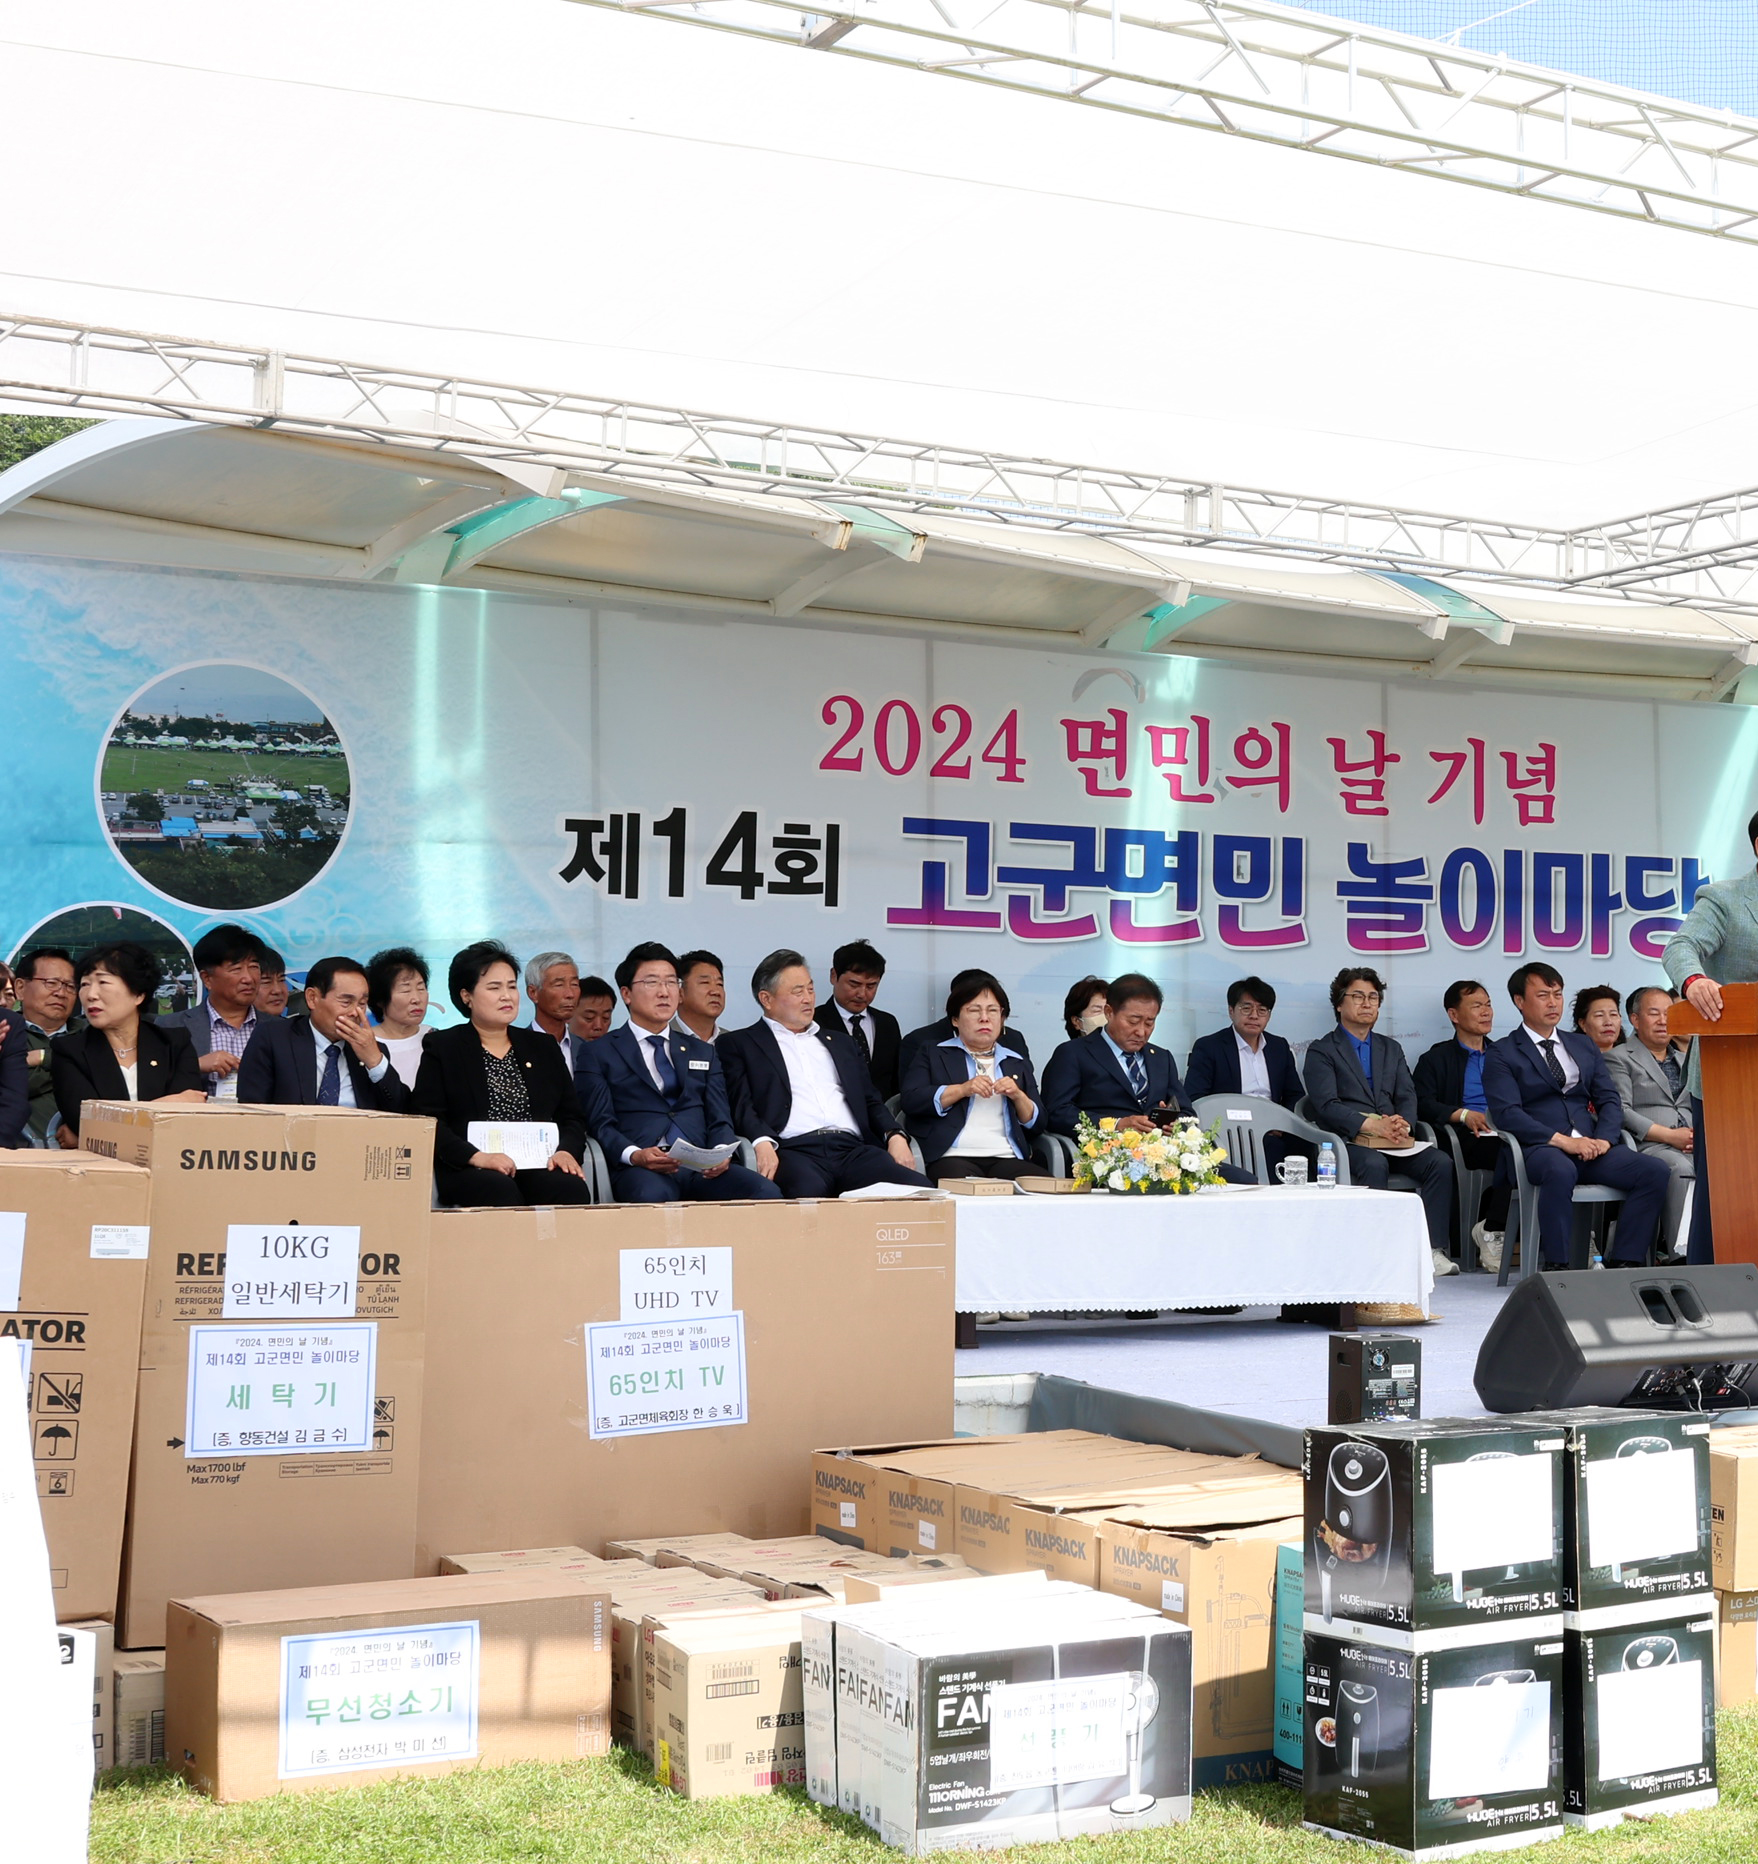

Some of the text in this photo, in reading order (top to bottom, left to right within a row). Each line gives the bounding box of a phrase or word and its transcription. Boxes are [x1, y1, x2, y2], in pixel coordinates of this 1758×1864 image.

[819, 695, 1557, 827] 2024 면민의 날 기념
[559, 807, 1712, 961] 제14회 고군면민 놀이마당
[180, 1149, 317, 1172] SAMSUNG
[876, 1229, 909, 1242] QLED
[260, 1236, 330, 1258] 10KG
[644, 1254, 707, 1276] 65인치
[232, 1282, 349, 1305] 일반세탁기
[634, 1290, 719, 1309] UHD TV
[268, 1338, 293, 1346] 면민의
[651, 1329, 674, 1338] 면민의
[677, 1328, 685, 1337] 날
[600, 1336, 731, 1358] 제14회 고군면민 놀이마당
[206, 1350, 360, 1366] 제14회 고군면민 놀이마당
[609, 1366, 725, 1396] 65인치 TV
[187, 1462, 246, 1473] Max 1700 lbf
[192, 1475, 240, 1484] Max 770 kgf
[816, 1470, 865, 1500] KNAPSACK
[889, 1491, 944, 1517] KNAPSACK
[961, 1505, 1010, 1535] KNAPSAC
[1025, 1528, 1086, 1560] KNAPSACK
[1113, 1545, 1179, 1577] KNAPSACK
[1642, 1582, 1681, 1594] AIR FRYER
[1683, 1571, 1708, 1589] 5.5L
[1487, 1603, 1529, 1615] AIR FRYER
[1532, 1592, 1559, 1610] 5.5L
[1731, 1599, 1742, 1608] LG
[1368, 1609, 1387, 1618] FRYER
[1388, 1605, 1409, 1623] 5.5L
[593, 1601, 602, 1652] SAMSUNG
[364, 1643, 391, 1653] 면민의
[397, 1641, 405, 1651] 날
[299, 1652, 461, 1679] 제14회 고군면민 놀이마당
[803, 1658, 830, 1691] FAN
[1355, 1662, 1388, 1673] AIR FRYER
[1390, 1661, 1410, 1679] 5.5L
[939, 1673, 960, 1683] 바람의
[962, 1682, 983, 1693] 기계식
[306, 1686, 453, 1725] 무선청소기
[884, 1692, 914, 1730] FAN
[339, 1743, 388, 1761] 삼성전자
[1688, 1767, 1712, 1787] 5.5L
[929, 1782, 950, 1791] Electric
[1342, 1786, 1369, 1798] KAF-2055
[1648, 1781, 1686, 1794] AIR FRYER
[1531, 1801, 1559, 1819] 5.5L
[1487, 1812, 1530, 1828] AIR FRYER
